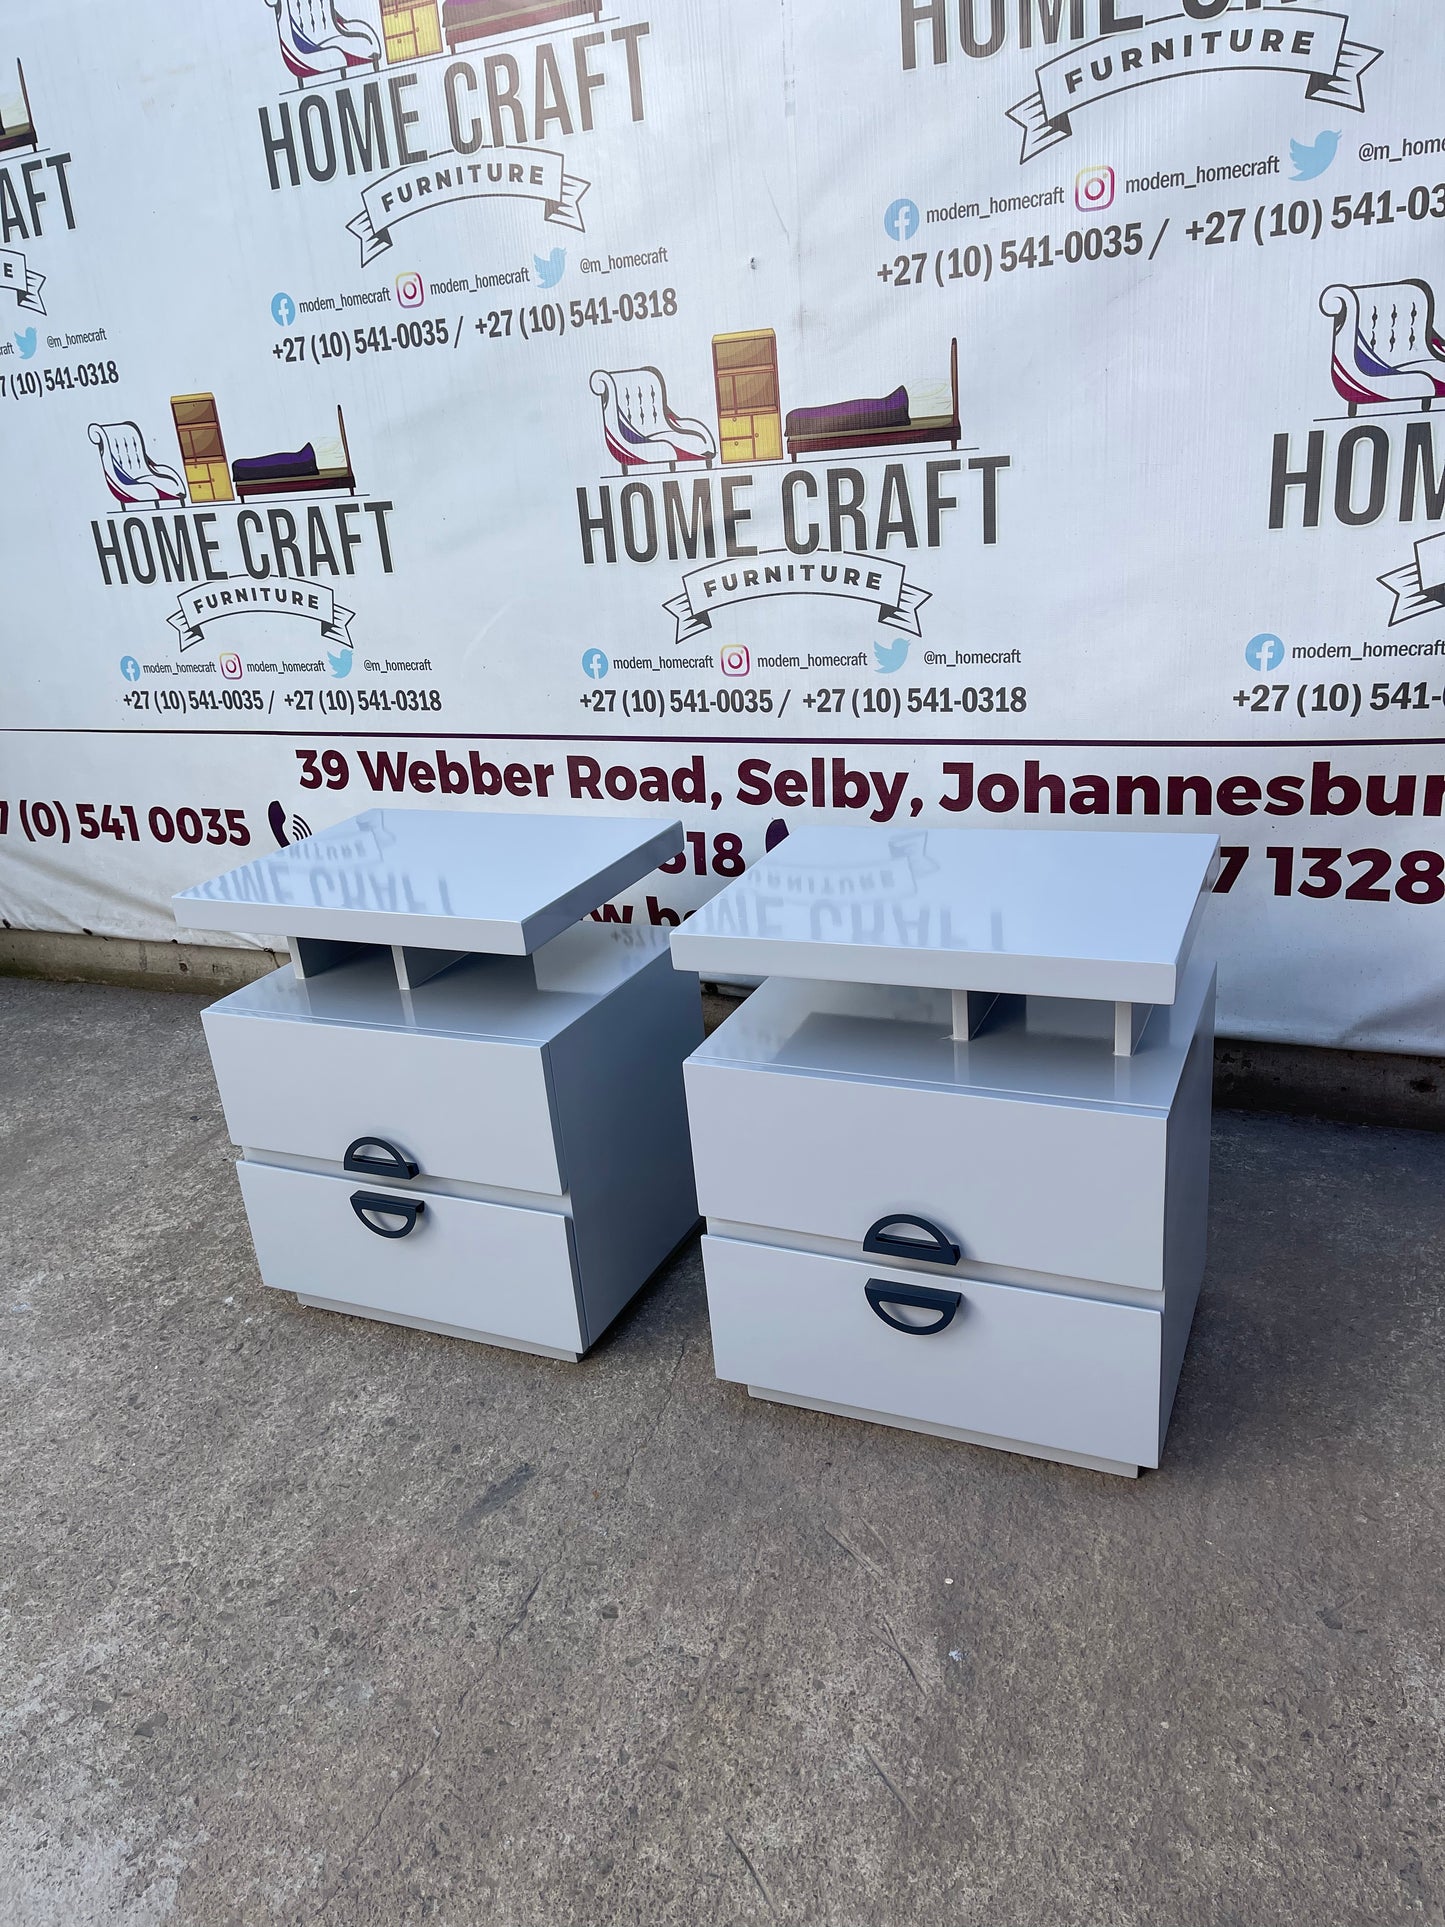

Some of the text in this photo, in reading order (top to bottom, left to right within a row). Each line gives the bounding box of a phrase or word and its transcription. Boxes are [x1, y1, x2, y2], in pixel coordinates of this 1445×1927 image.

[1064, 28, 1315, 94] FURNITURE
[258, 22, 650, 190] HOME CRAFT
[381, 162, 545, 213] FURNITURE
[926, 186, 1065, 224] modern_homecraft
[1125, 155, 1280, 193] modern_homecraft
[877, 252, 928, 287] +27
[935, 243, 992, 287] (10)
[999, 221, 1143, 272] 541-0035
[1185, 208, 1246, 246] +27
[1253, 199, 1322, 246] (10)
[299, 247, 668, 313] modern_homecraft modern_homecraft @m_homecraft
[46, 327, 107, 349] @m_homecraft
[272, 336, 305, 363] +27
[311, 331, 350, 364] (10)
[354, 318, 449, 354] 541-0035
[475, 309, 513, 338] +27
[519, 303, 565, 340] (10)
[570, 287, 678, 328] 541-0318
[10, 370, 43, 401] (10)
[43, 360, 119, 392] 541-0318
[576, 455, 1011, 565] HOME CRAFT
[90, 501, 394, 586] HOME CRAFT
[193, 587, 319, 614] FURNITURE
[703, 564, 882, 597] FURNITURE
[143, 658, 432, 676] modern_homecraft modern_homecraft @m_homecraft
[613, 649, 1021, 672] modern_homecraft modern_homecraft @m_homecraft
[123, 690, 150, 710] +27
[153, 689, 187, 715] (10)
[189, 689, 264, 711] 541-0035
[284, 689, 315, 711] +27
[319, 689, 355, 715] (10)
[358, 689, 443, 712] 541-0318
[580, 689, 617, 712] +27
[622, 689, 665, 717] (10)
[670, 689, 773, 713] 541-0035
[802, 688, 846, 713] +27
[852, 688, 901, 718] (10)
[907, 687, 1027, 713] 541-0318
[1232, 681, 1445, 718] +27 (10) 541-
[295, 749, 350, 790] 39
[356, 749, 556, 798] Webber
[566, 755, 722, 810] Road,
[736, 757, 924, 823] Selby,
[19, 799, 70, 843] (0)
[76, 803, 140, 841] 541
[148, 806, 251, 847] 0035
[1266, 846, 1445, 905] 1328
